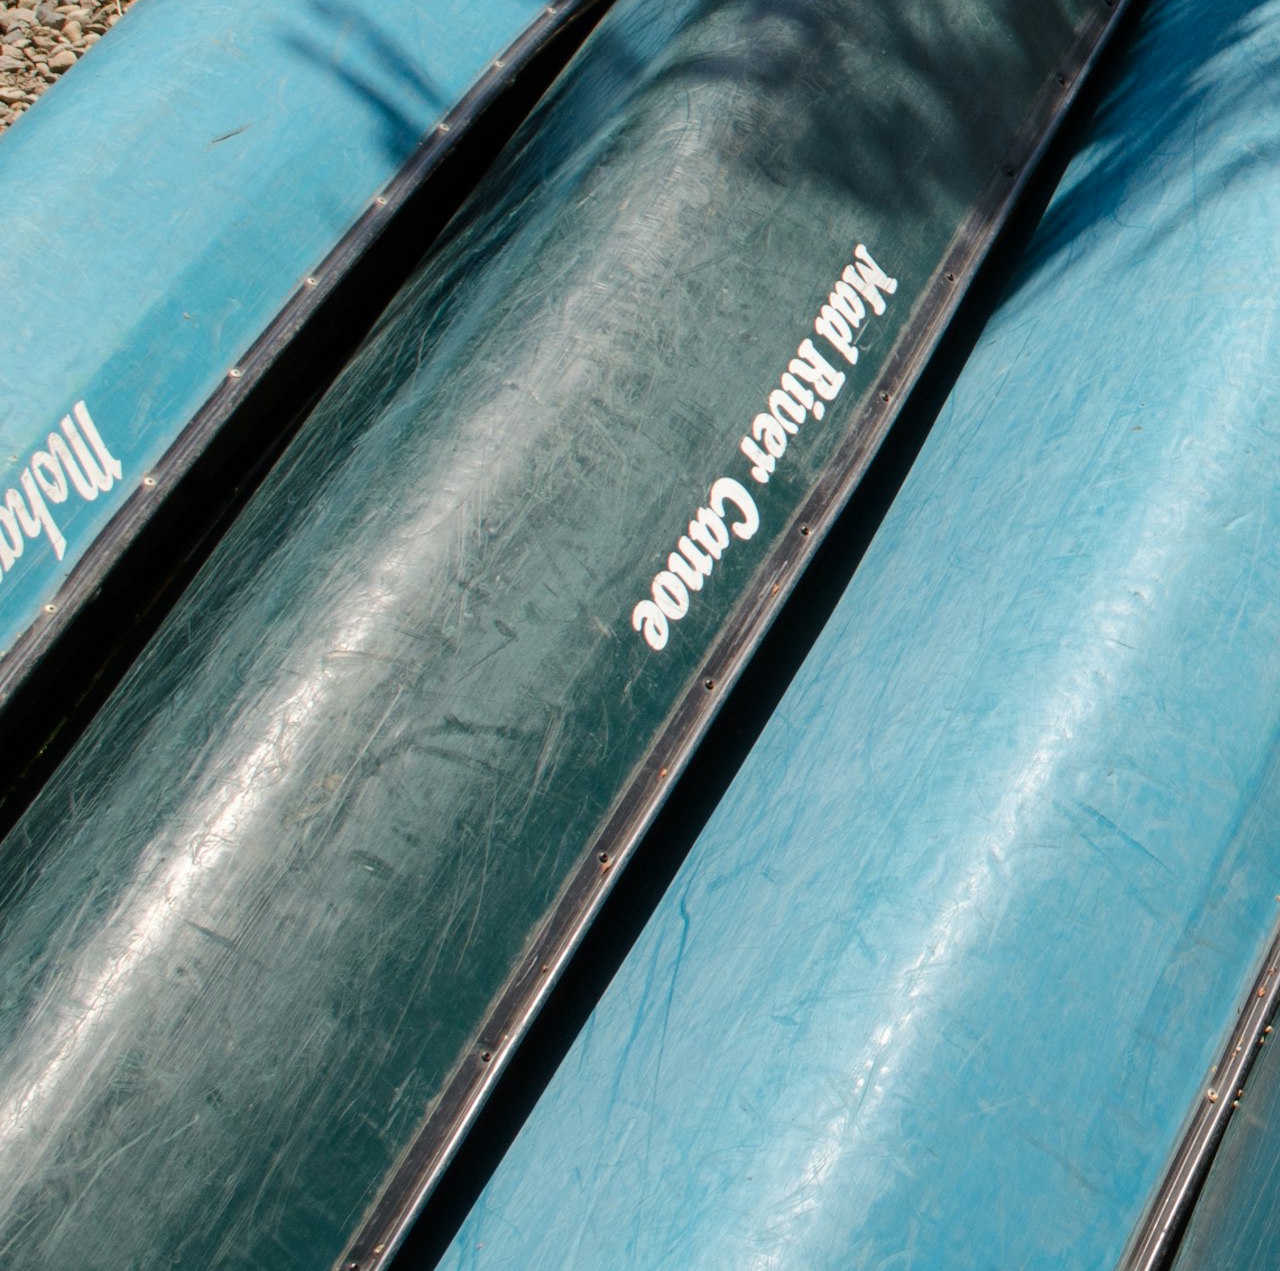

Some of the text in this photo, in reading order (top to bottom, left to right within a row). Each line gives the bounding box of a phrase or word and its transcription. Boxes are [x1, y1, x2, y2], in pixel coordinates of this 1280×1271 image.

[0, 399, 123, 585] Moha
[632, 243, 897, 651] Mad River Canoe
